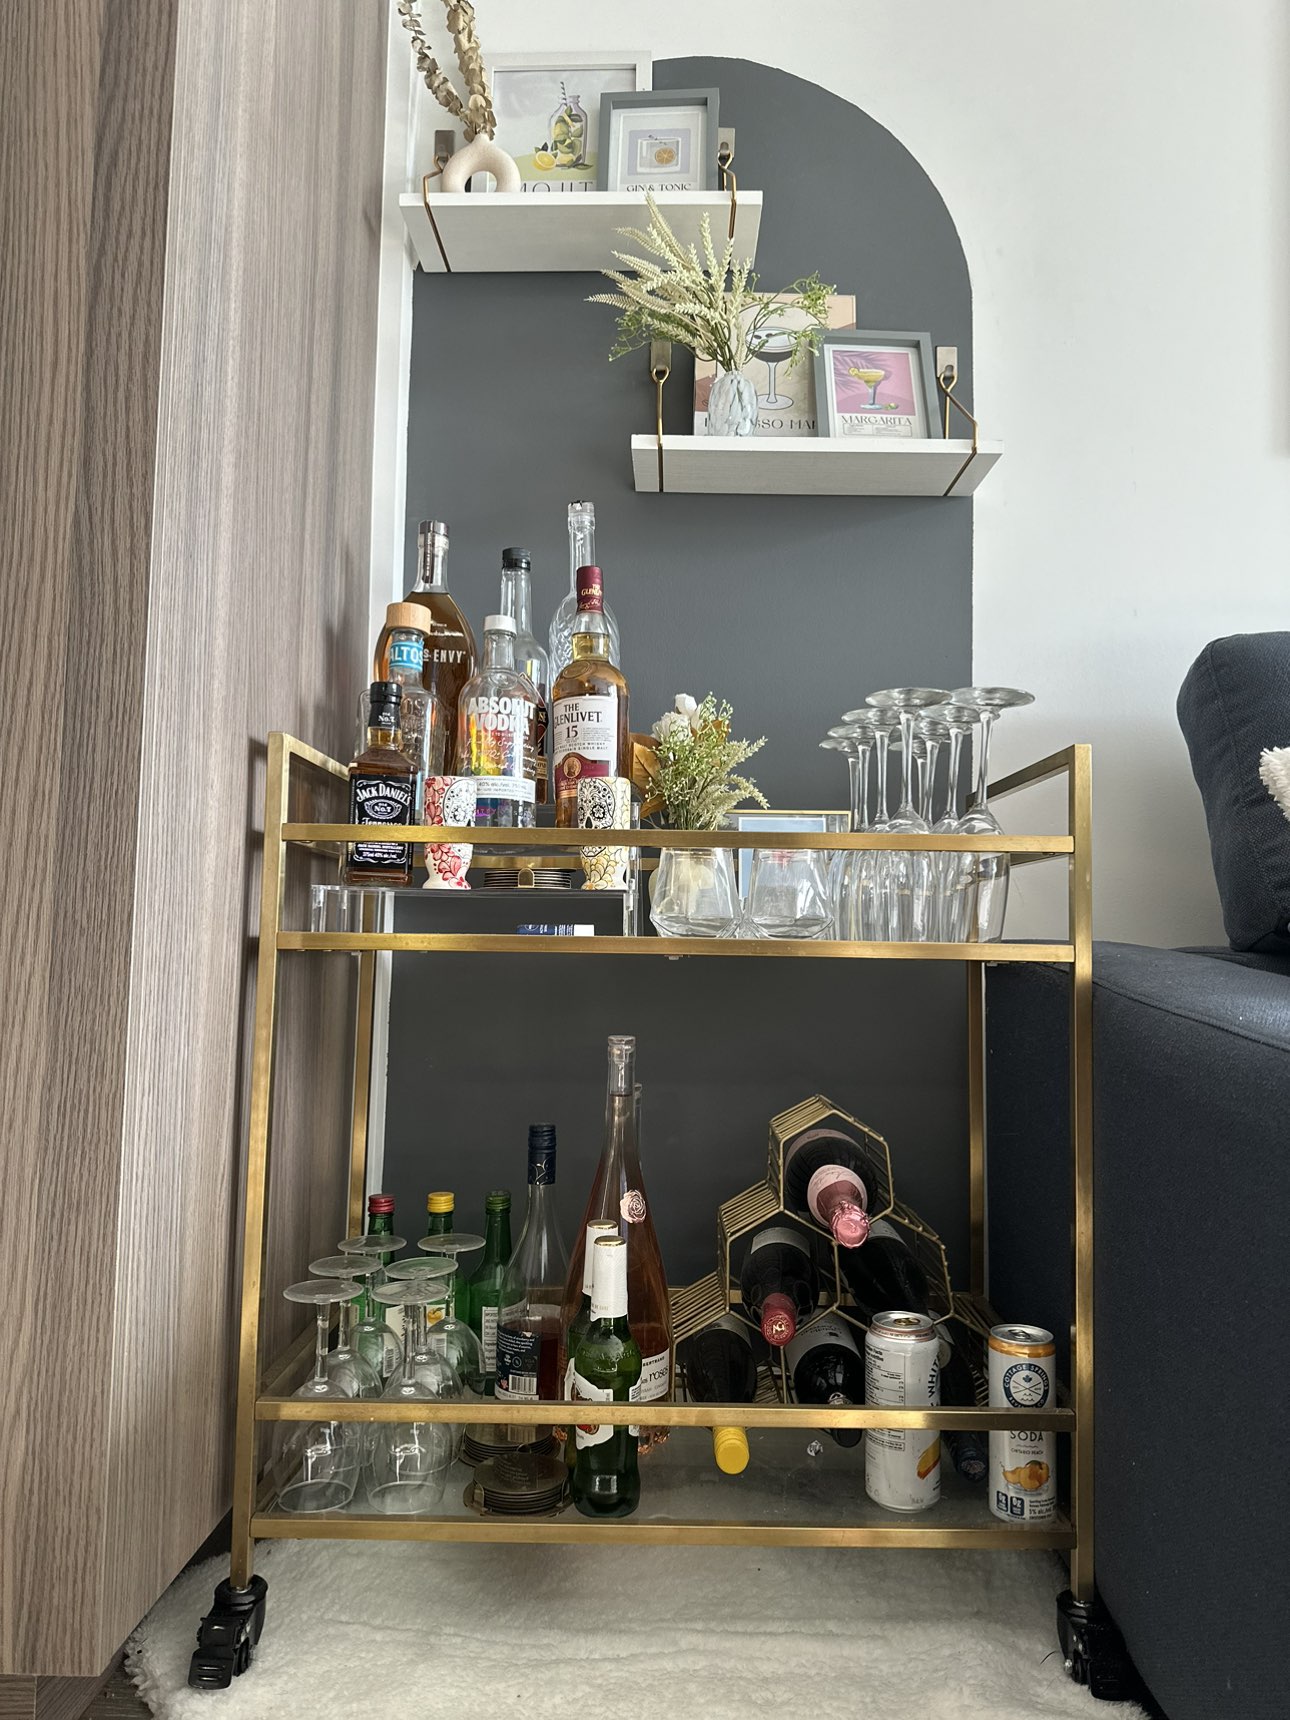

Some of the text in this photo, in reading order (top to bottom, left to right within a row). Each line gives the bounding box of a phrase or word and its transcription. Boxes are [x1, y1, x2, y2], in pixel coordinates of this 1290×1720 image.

[626, 183, 692, 192] GIN & TONIC
[841, 415, 913, 426] MARGARITA
[433, 648, 462, 664] ENVY
[563, 703, 580, 713] THE
[566, 725, 578, 739] 15
[356, 782, 412, 806] JACK DANIEL'S
[1004, 1364, 1049, 1391] COTTAGE SPRINGS
[1010, 1430, 1044, 1442] SODA
